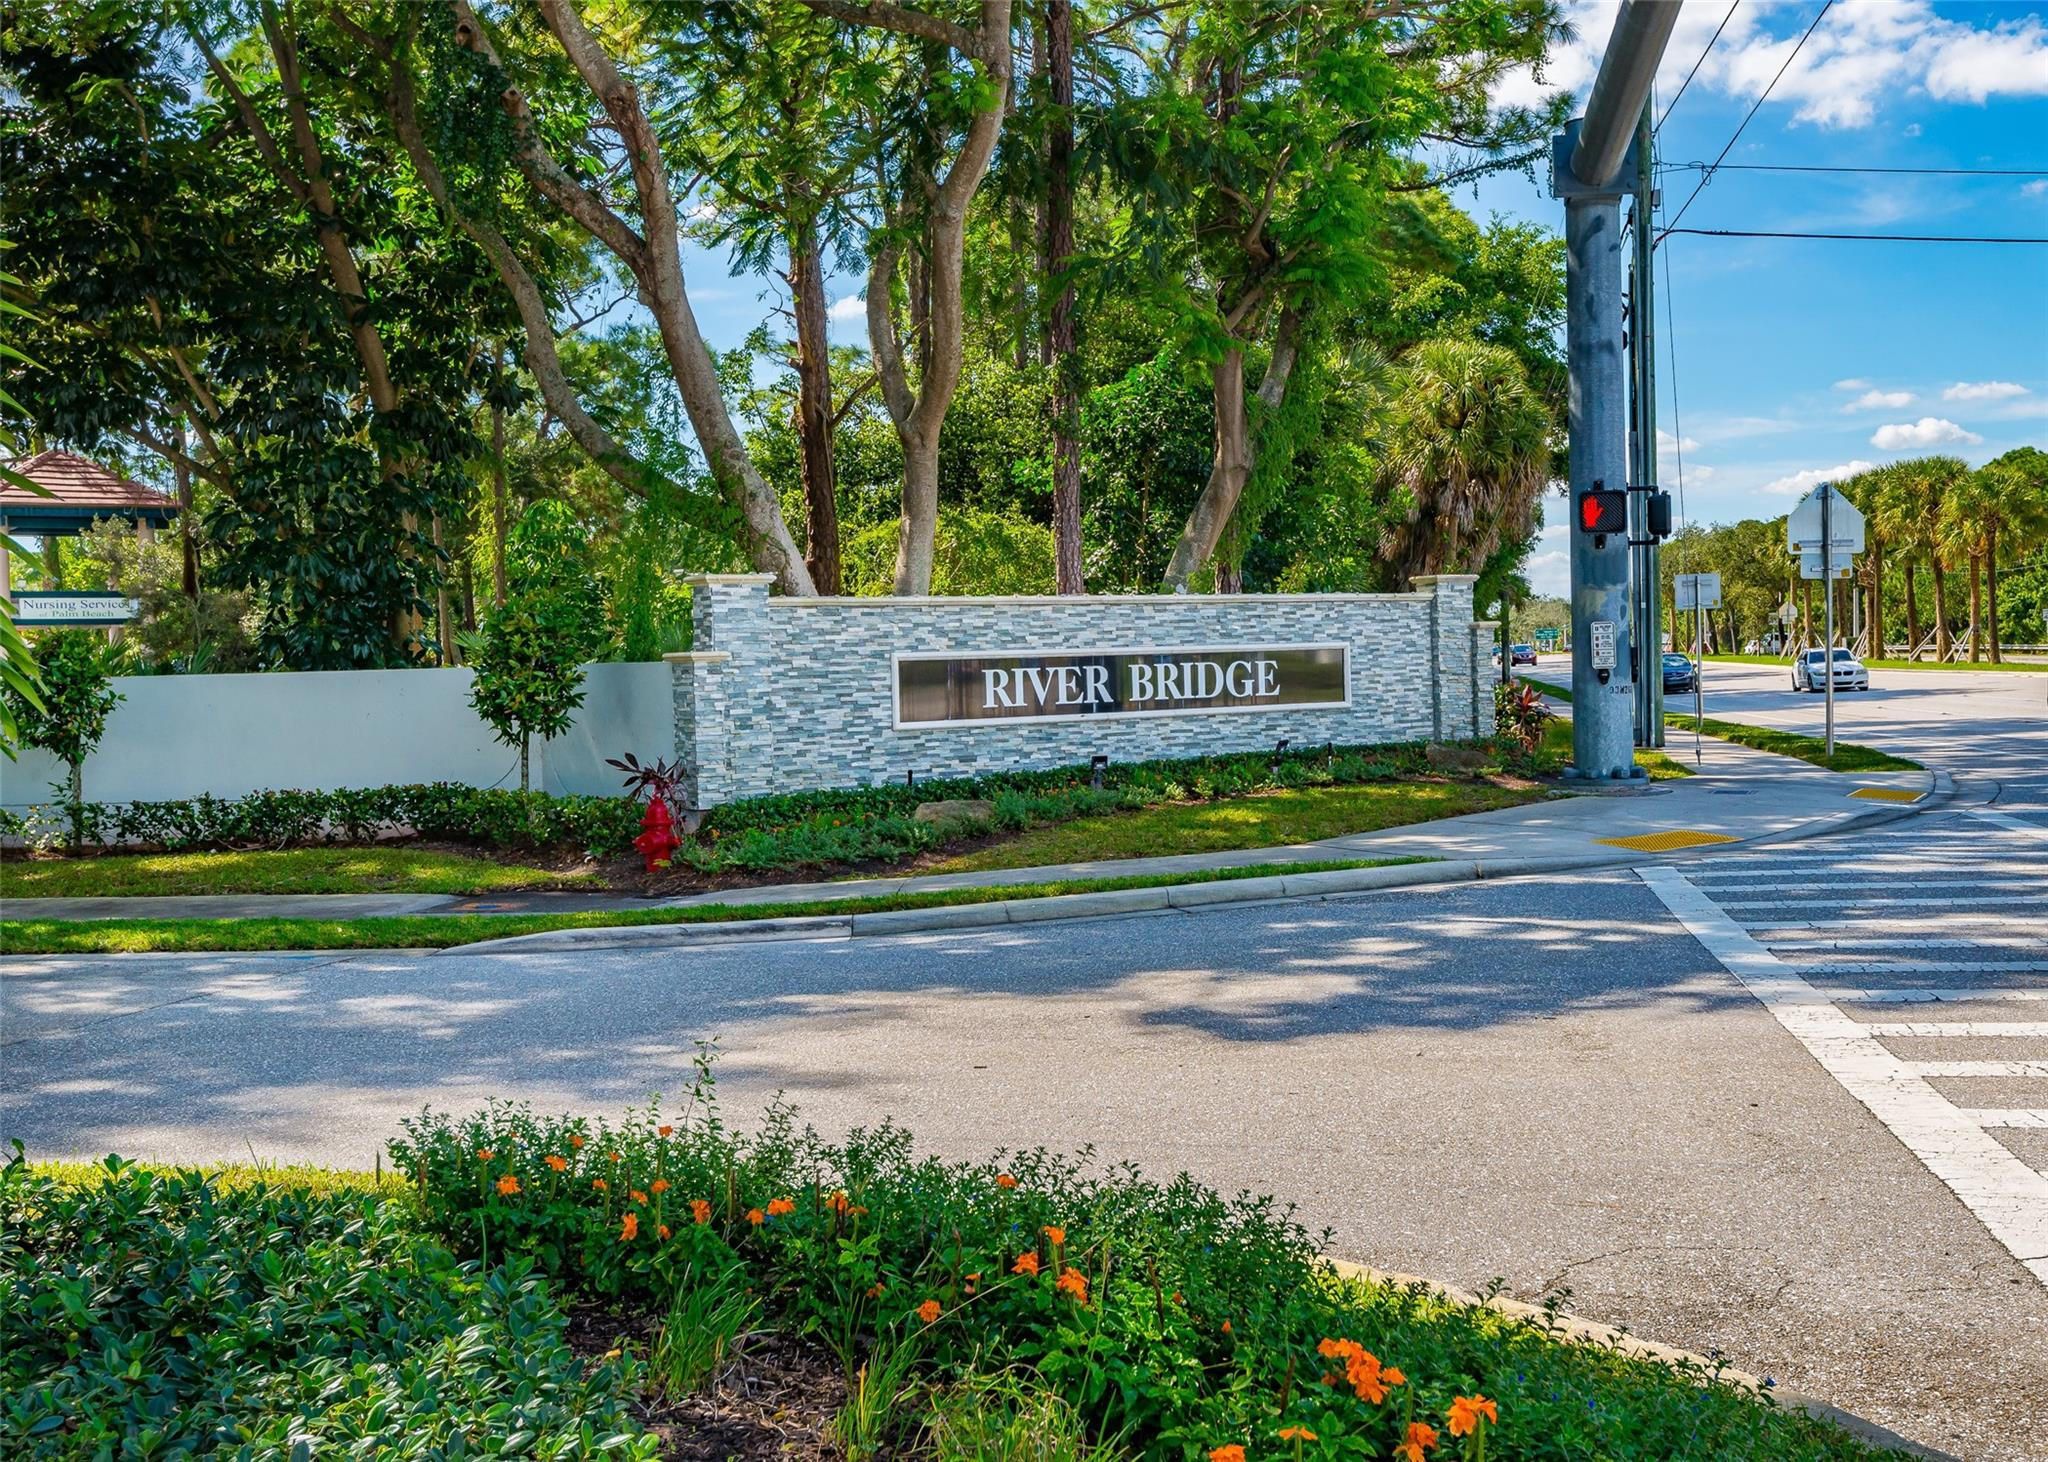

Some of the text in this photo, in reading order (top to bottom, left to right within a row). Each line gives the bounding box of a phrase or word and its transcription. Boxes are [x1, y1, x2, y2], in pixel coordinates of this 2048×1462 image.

[23, 599, 130, 611] Nursing Services
[981, 660, 1280, 708] RIVER BRIDGE
